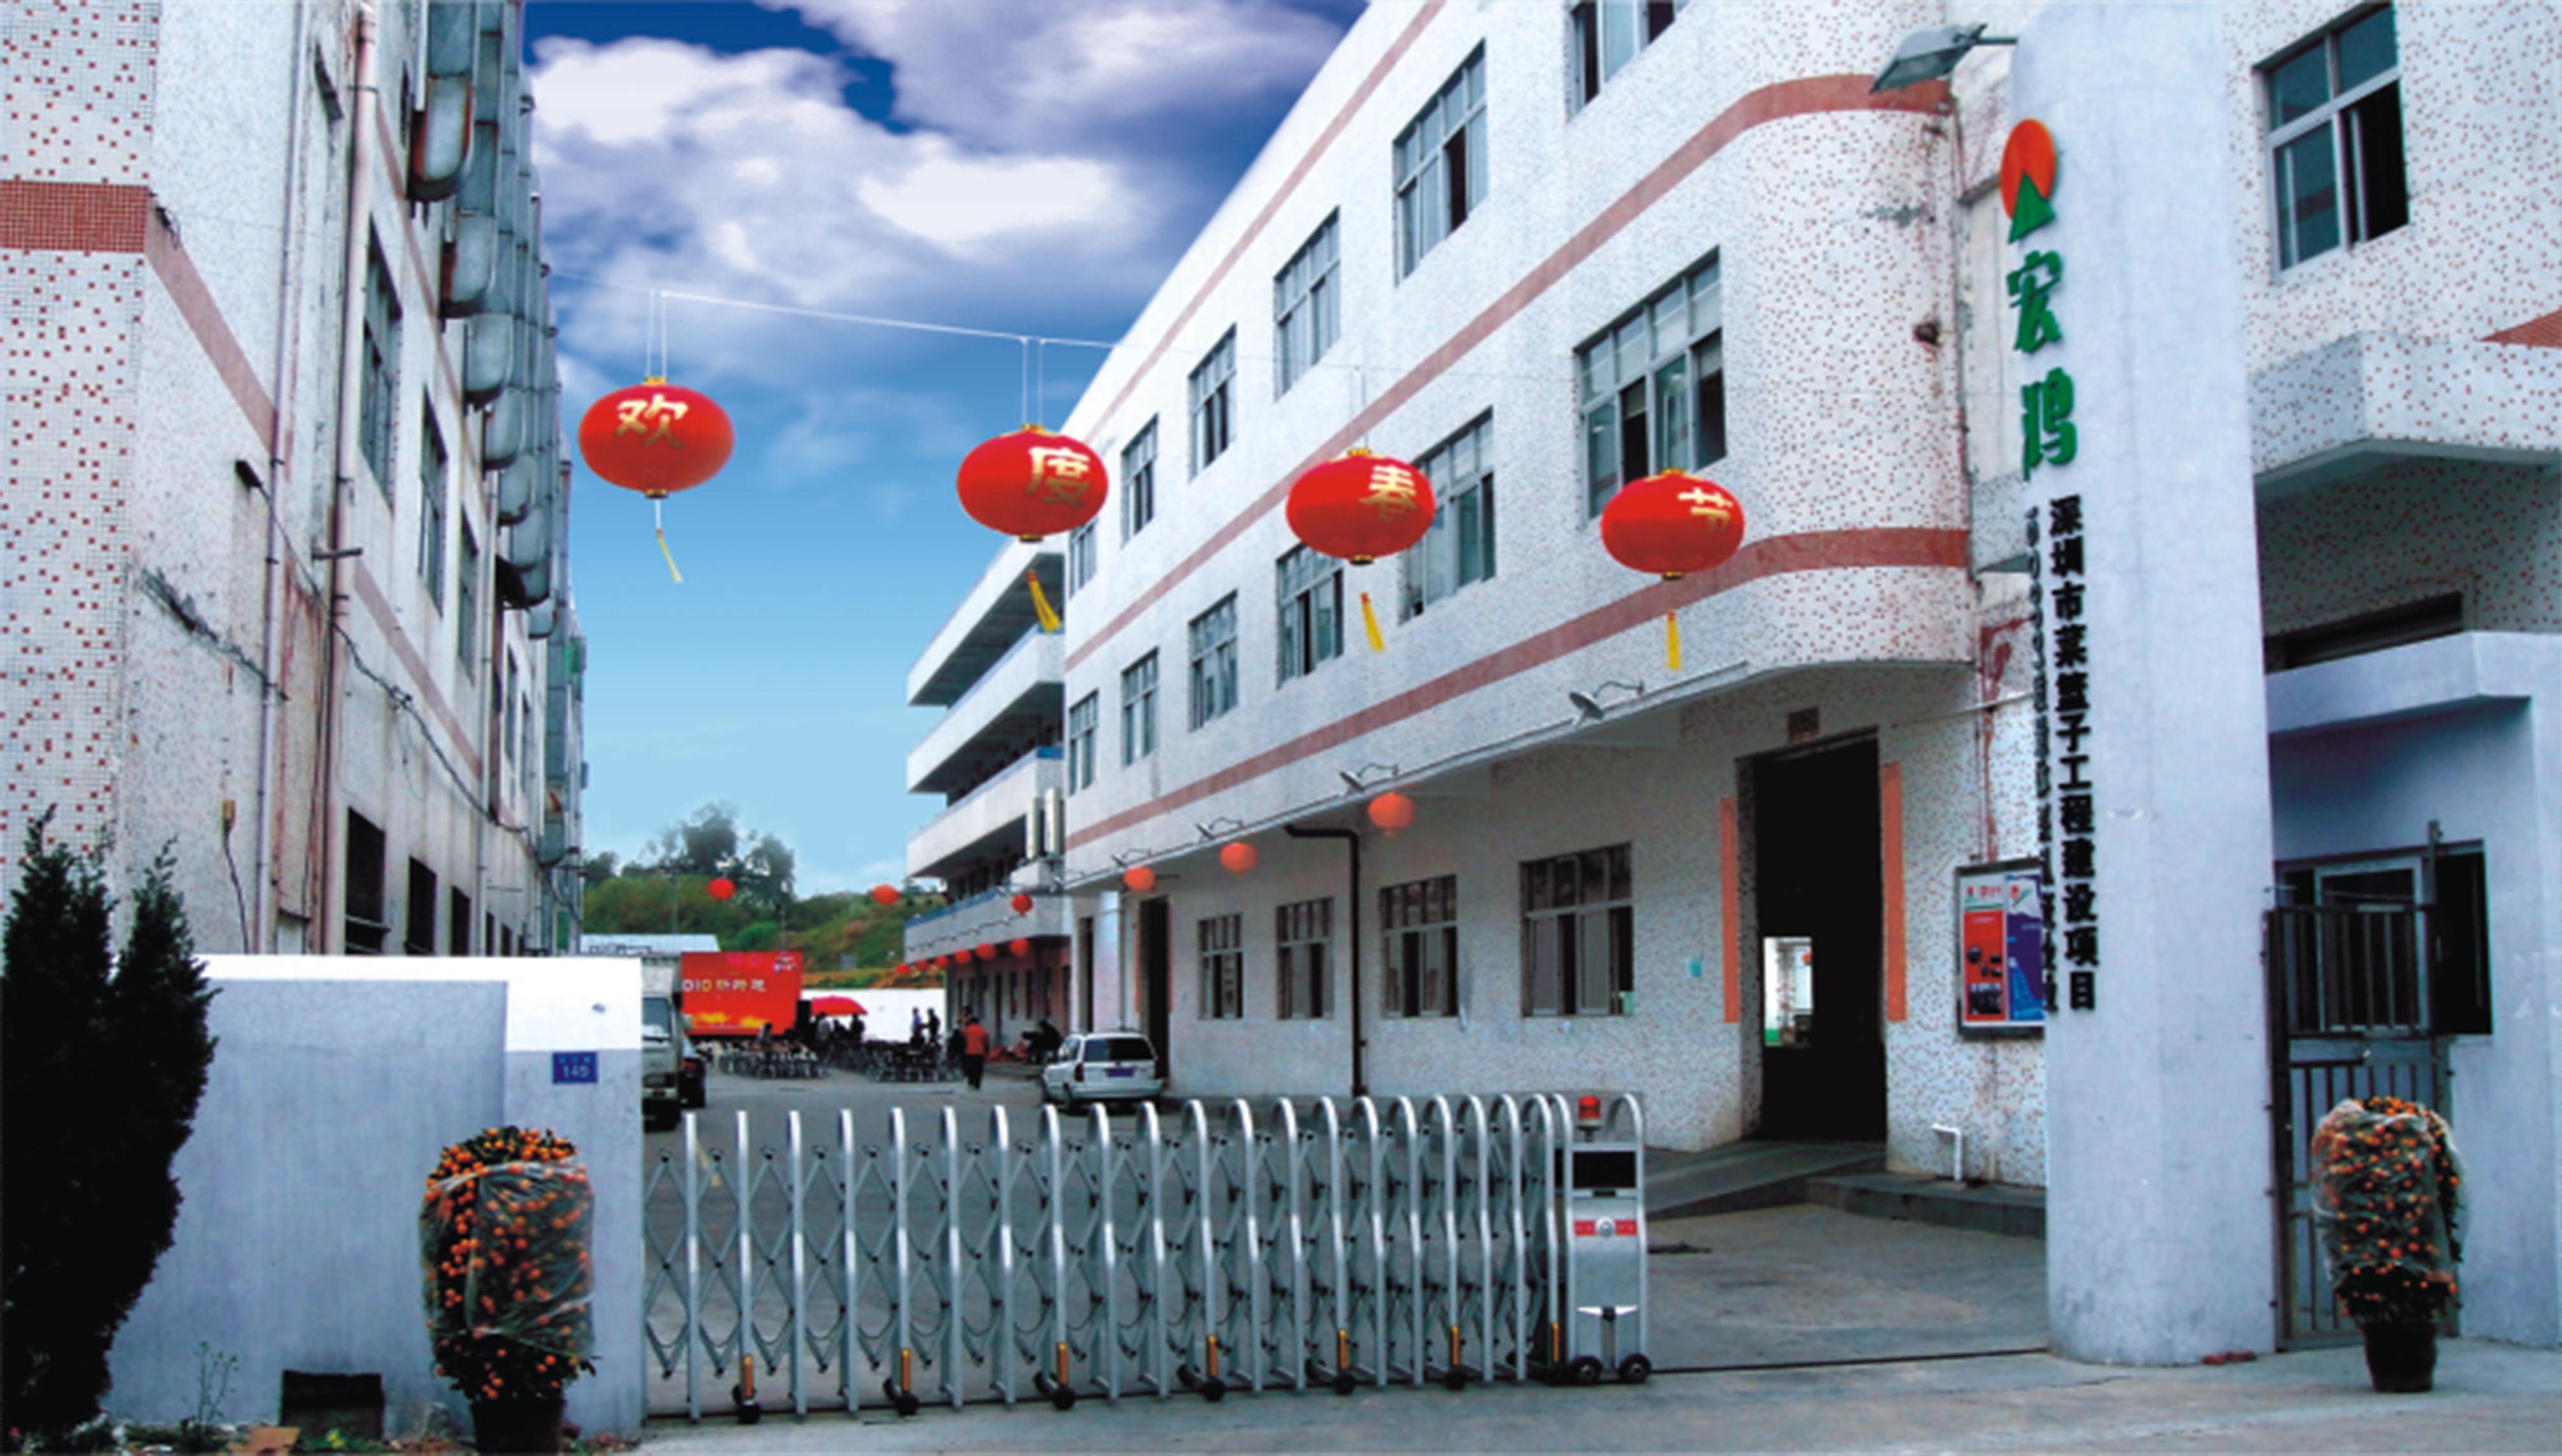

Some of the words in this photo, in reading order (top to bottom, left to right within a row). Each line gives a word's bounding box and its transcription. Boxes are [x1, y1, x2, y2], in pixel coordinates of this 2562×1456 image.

[615, 394, 689, 449] 欢
[1026, 445, 1092, 508] 度
[1360, 465, 1419, 521] 春
[1677, 487, 1733, 540] 节
[2049, 494, 2099, 1011] 深圳市菜篮子工程建设项目
